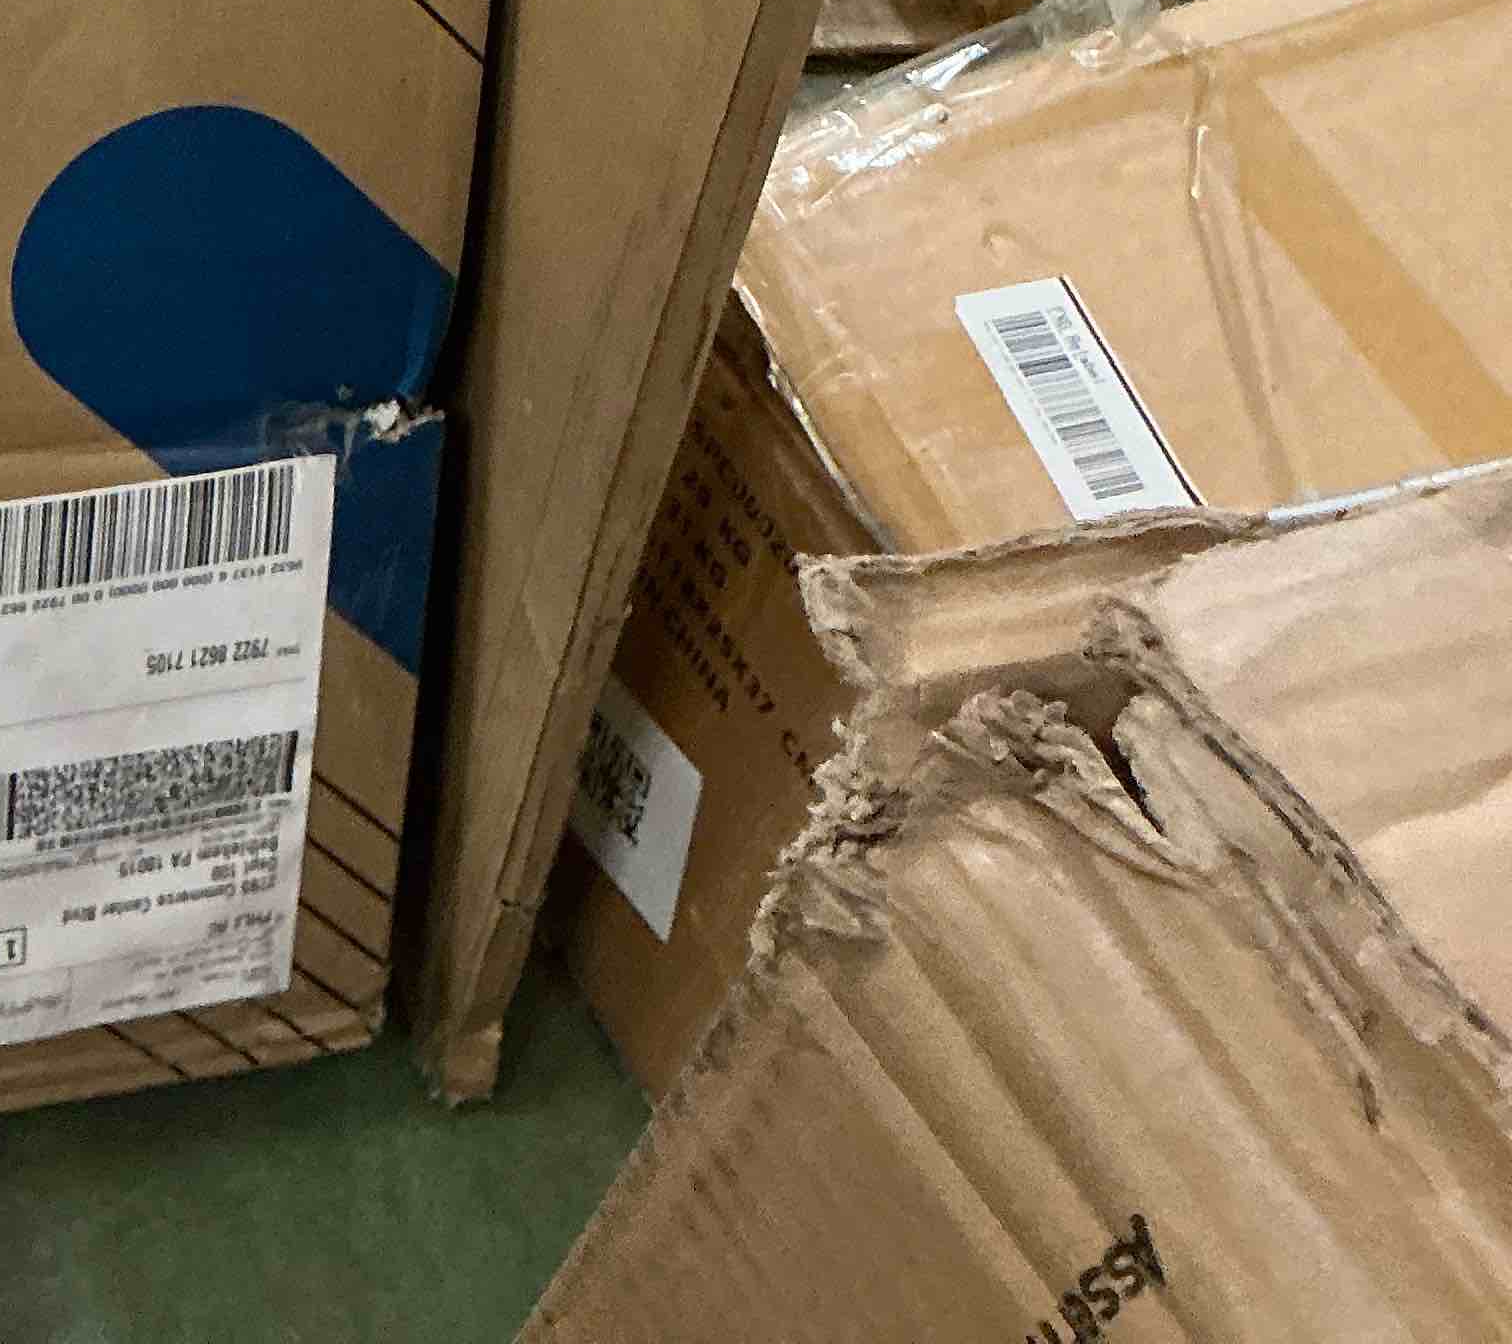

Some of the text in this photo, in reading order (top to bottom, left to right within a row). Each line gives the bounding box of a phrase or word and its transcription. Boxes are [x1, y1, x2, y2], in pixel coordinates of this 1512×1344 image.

[189, 642, 227, 670] 8621
[232, 635, 270, 662] 7922
[144, 649, 183, 678] 7105
